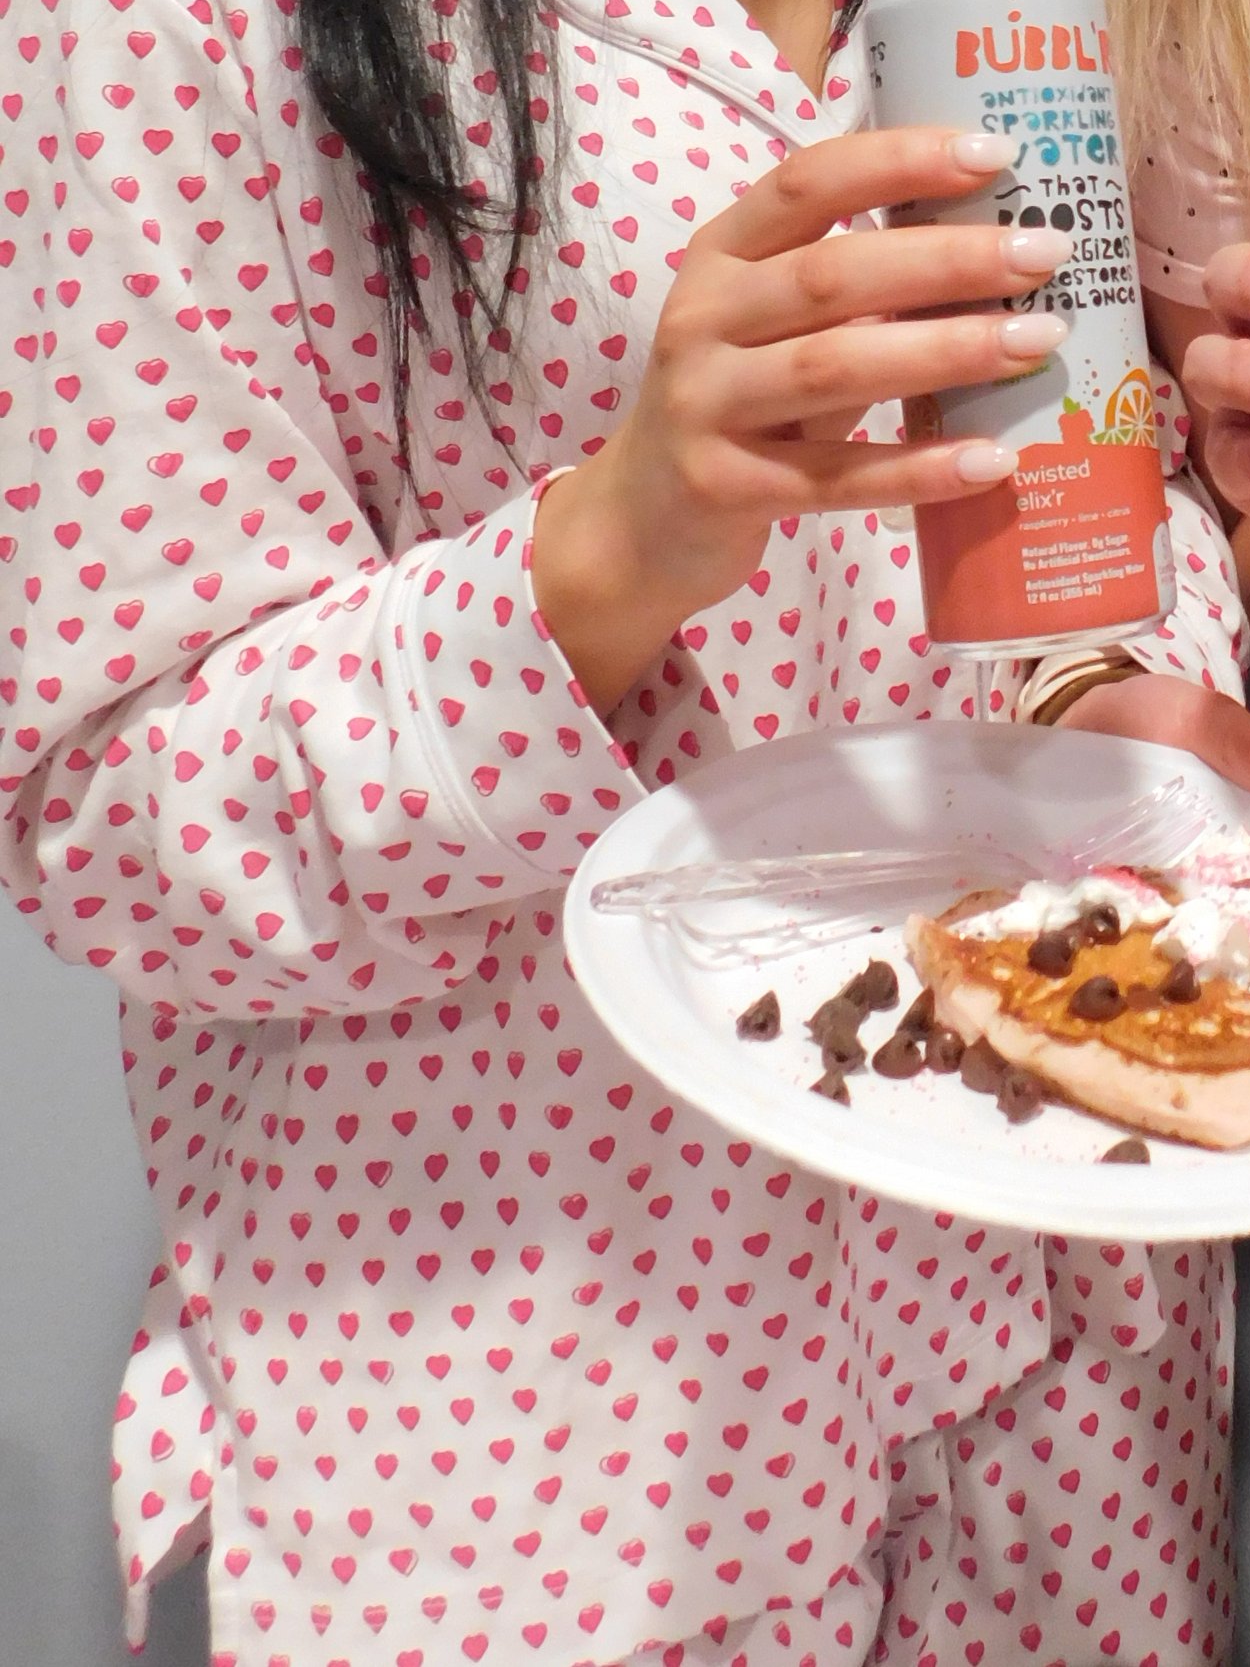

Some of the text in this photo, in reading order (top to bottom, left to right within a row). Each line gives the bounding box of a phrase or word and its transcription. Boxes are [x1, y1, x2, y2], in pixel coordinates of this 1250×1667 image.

[1013, 458, 1090, 487] twisted
[1016, 488, 1064, 511] elix'r
[1019, 507, 1130, 531] raspberry lime citrus
[1021, 544, 1057, 557] Natural
[1038, 553, 1080, 569] Artificial
[1082, 568, 1124, 584] Sparkling
